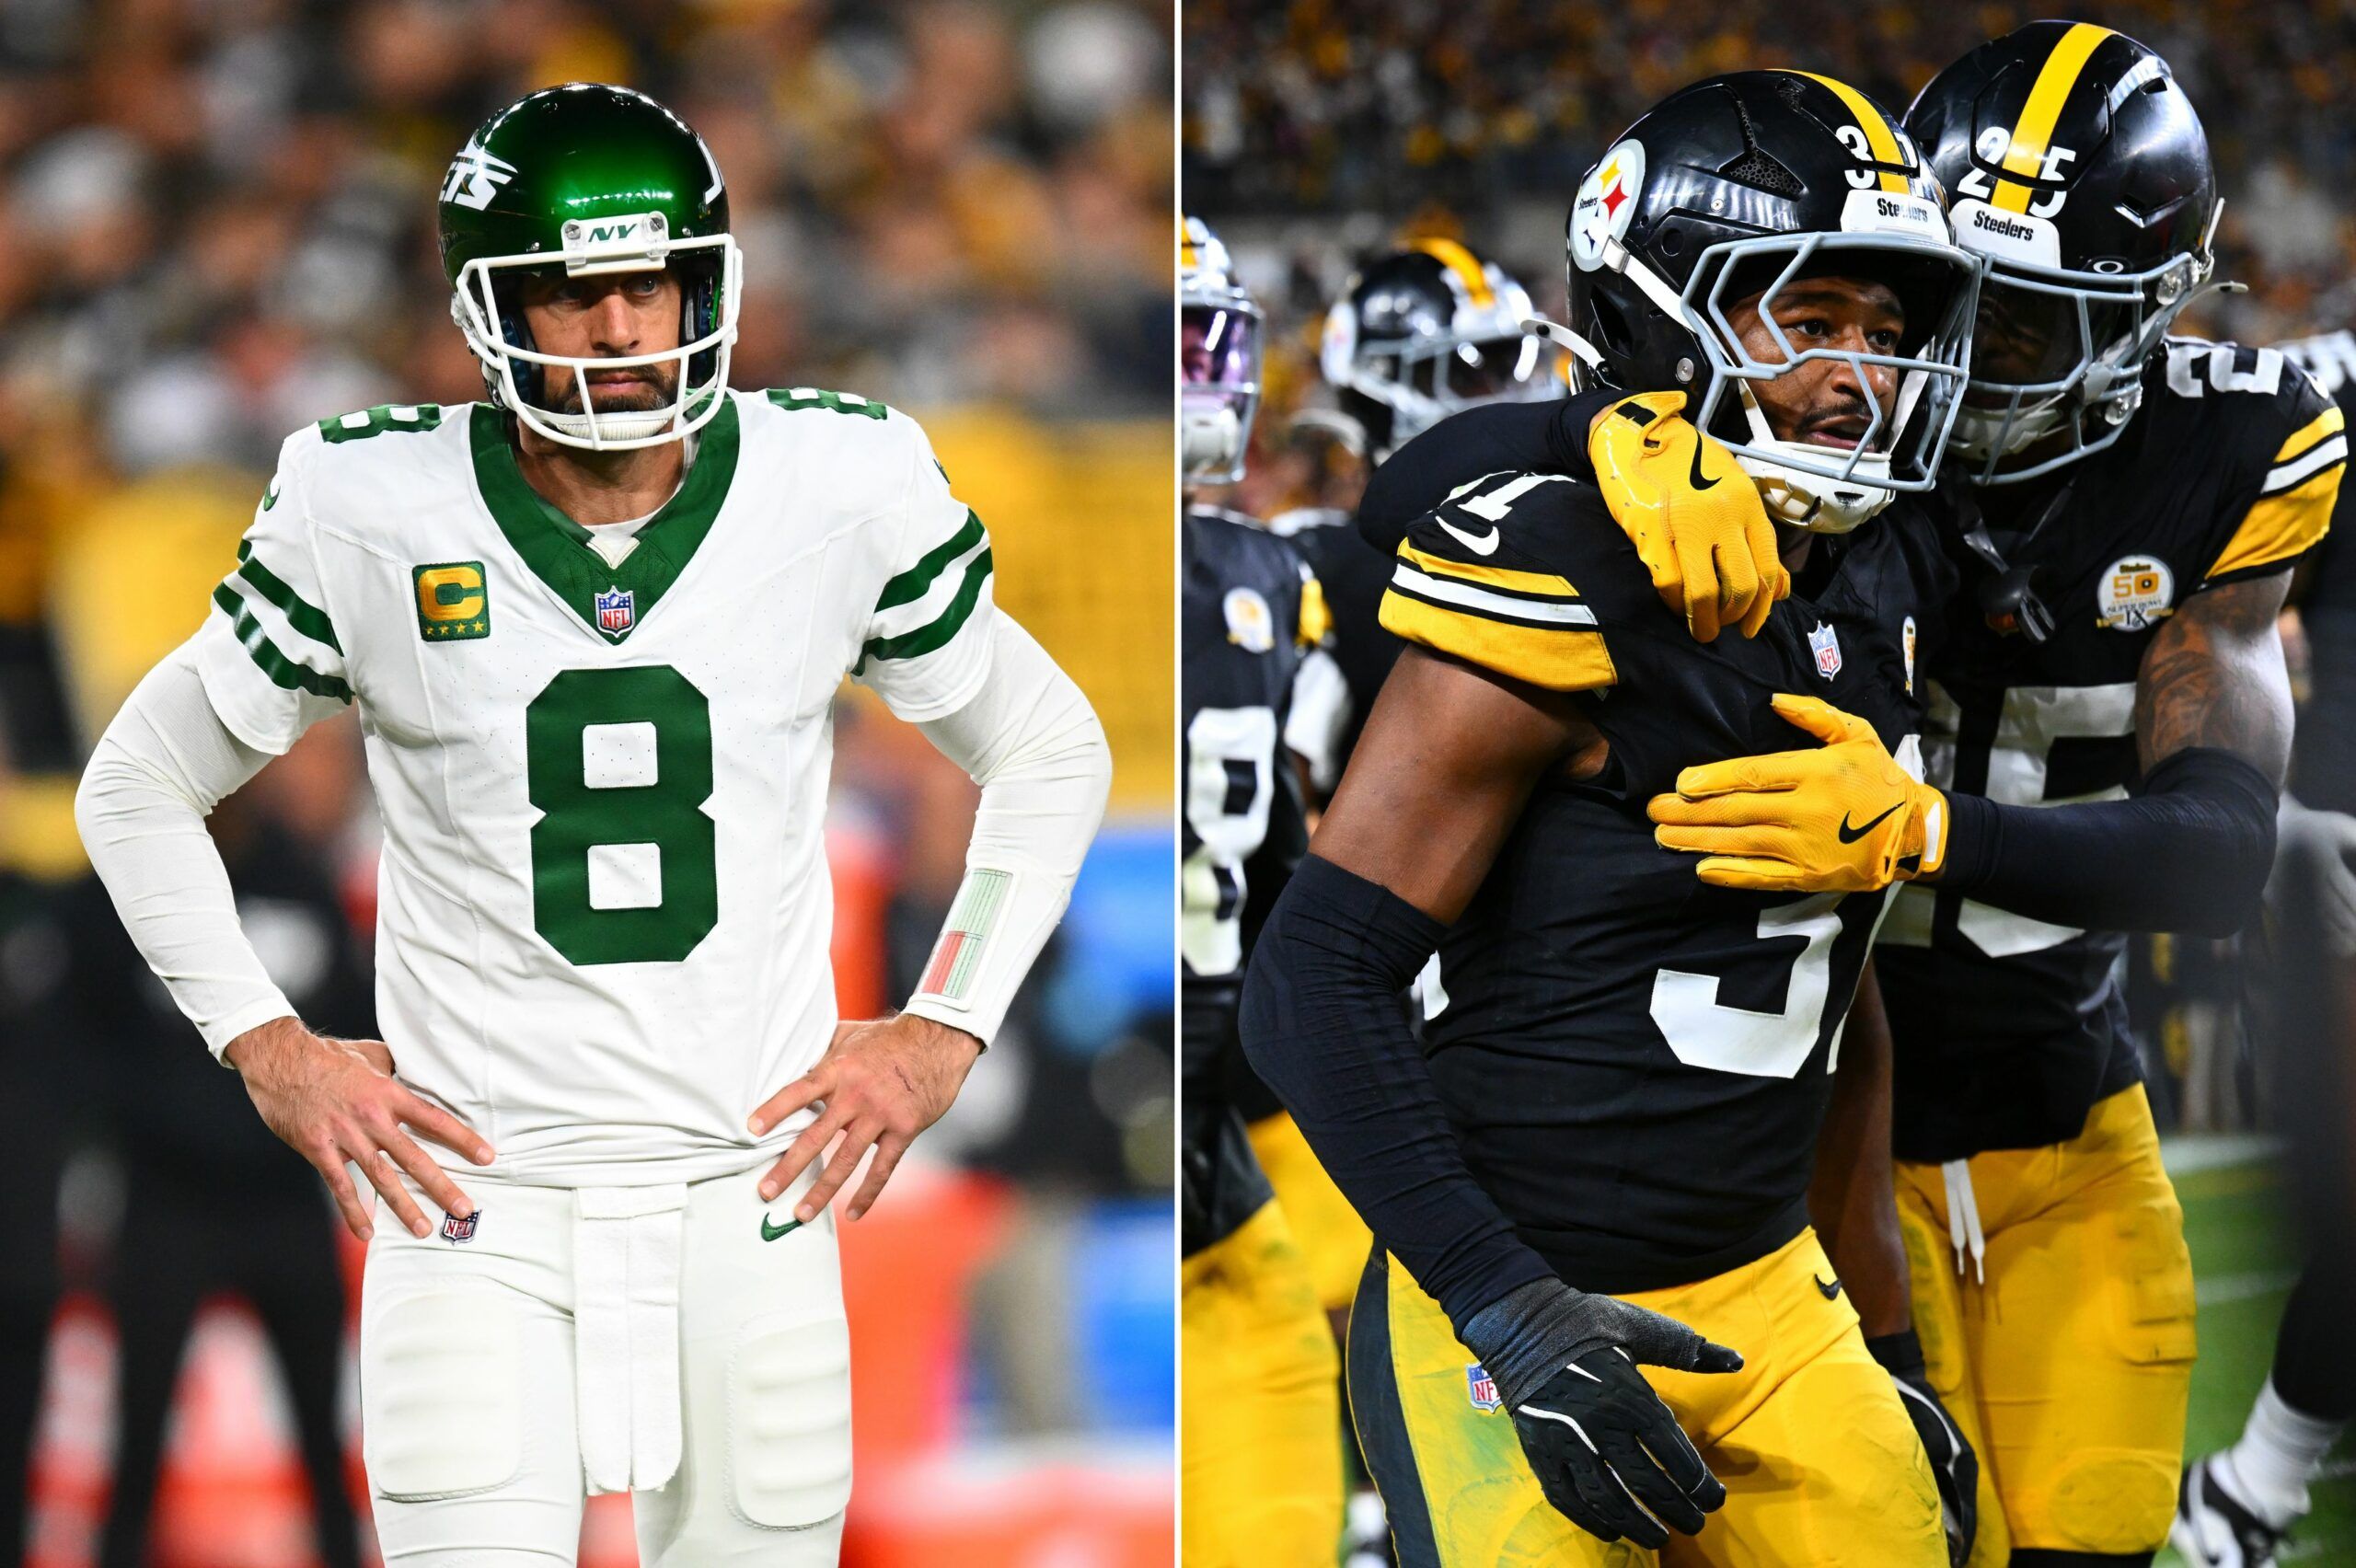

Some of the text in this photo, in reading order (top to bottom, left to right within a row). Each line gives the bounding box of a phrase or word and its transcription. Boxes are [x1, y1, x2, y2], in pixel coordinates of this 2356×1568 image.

[1957, 125, 2077, 219] 25
[587, 223, 638, 243] NY
[1973, 209, 2034, 242] Steelers
[417, 566, 484, 622] C
[2112, 571, 2159, 599] 50
[601, 609, 629, 629] NFL
[1818, 647, 1839, 670] NFL
[525, 663, 719, 966] 8
[445, 1220, 471, 1238] NFL
[1473, 1379, 1501, 1402] NF
